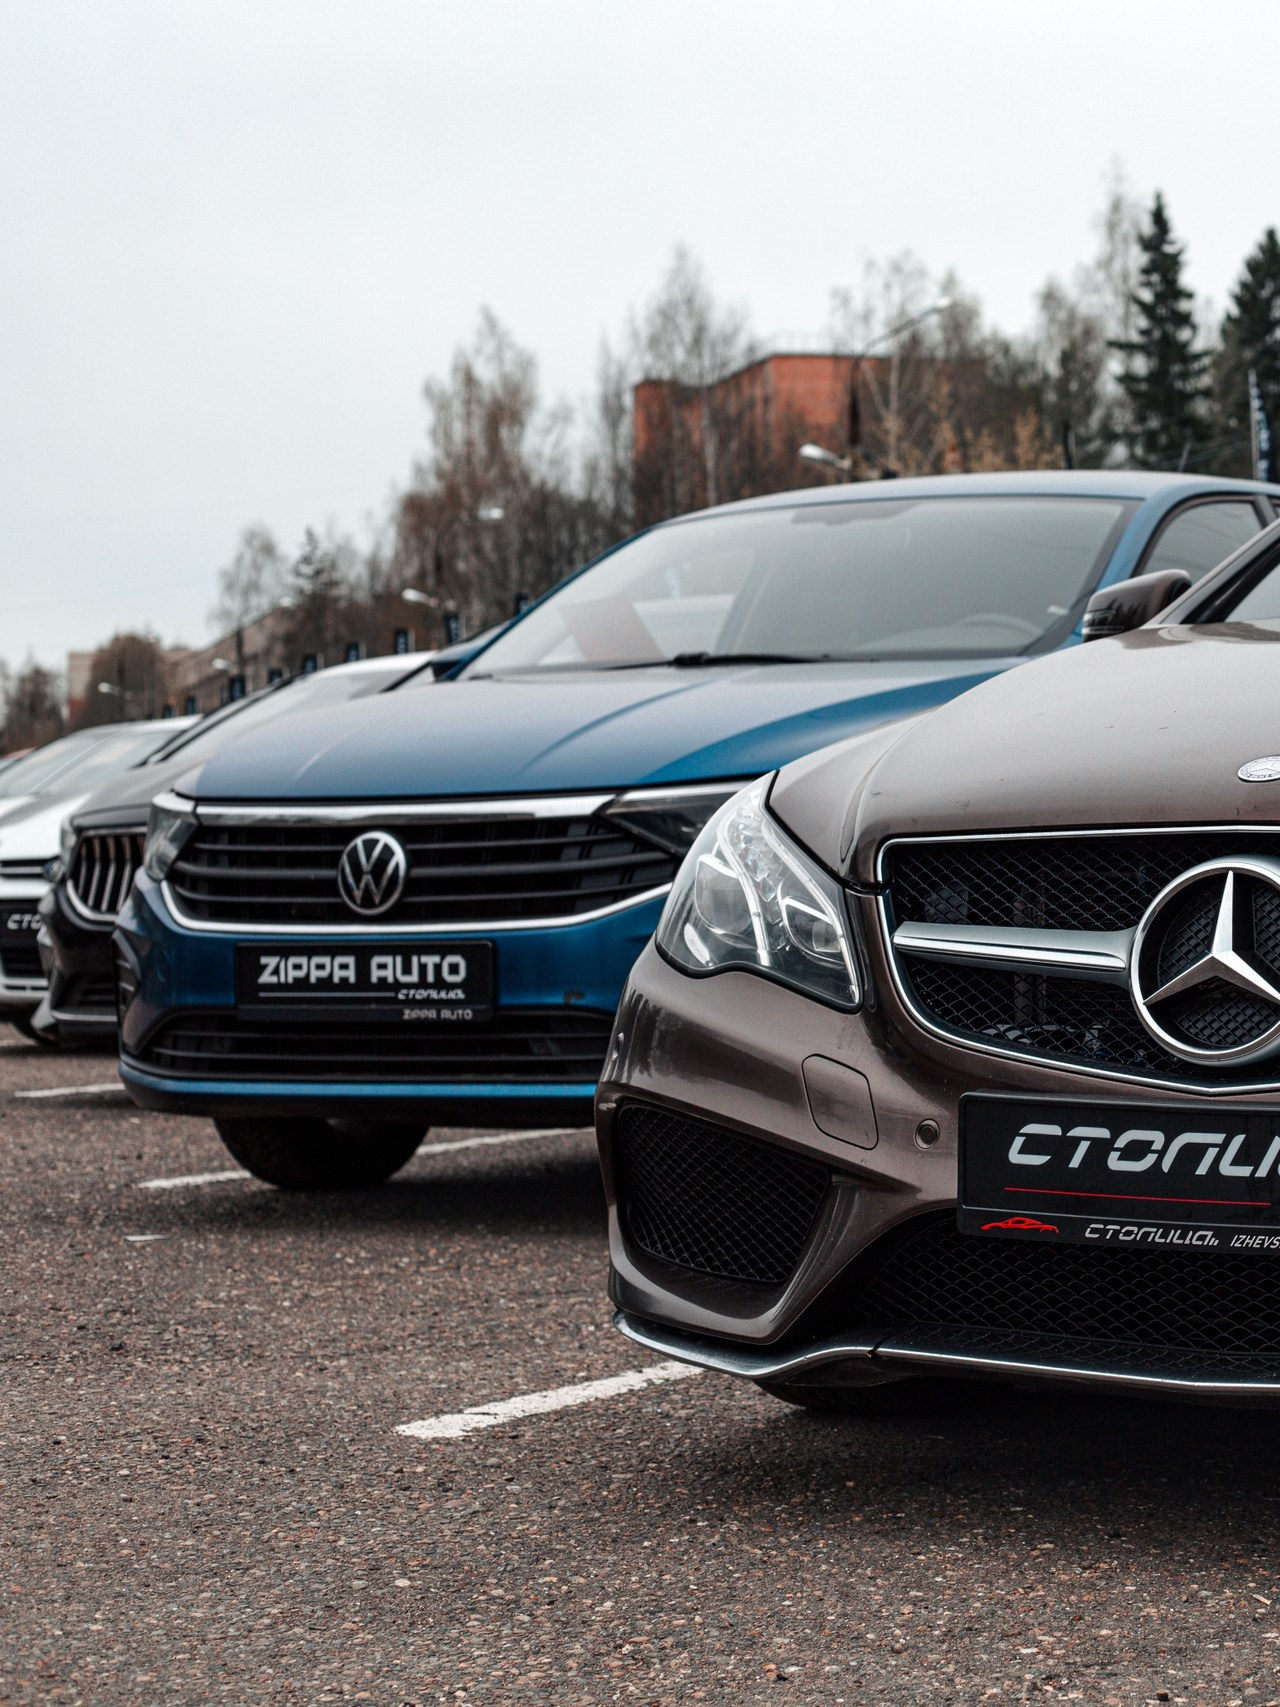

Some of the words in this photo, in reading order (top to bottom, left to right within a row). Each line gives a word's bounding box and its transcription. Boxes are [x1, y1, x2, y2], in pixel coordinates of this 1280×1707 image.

[257, 955, 356, 984] ZIPPA
[370, 954, 467, 984] AUTO
[440, 1008, 473, 1020] AUTO
